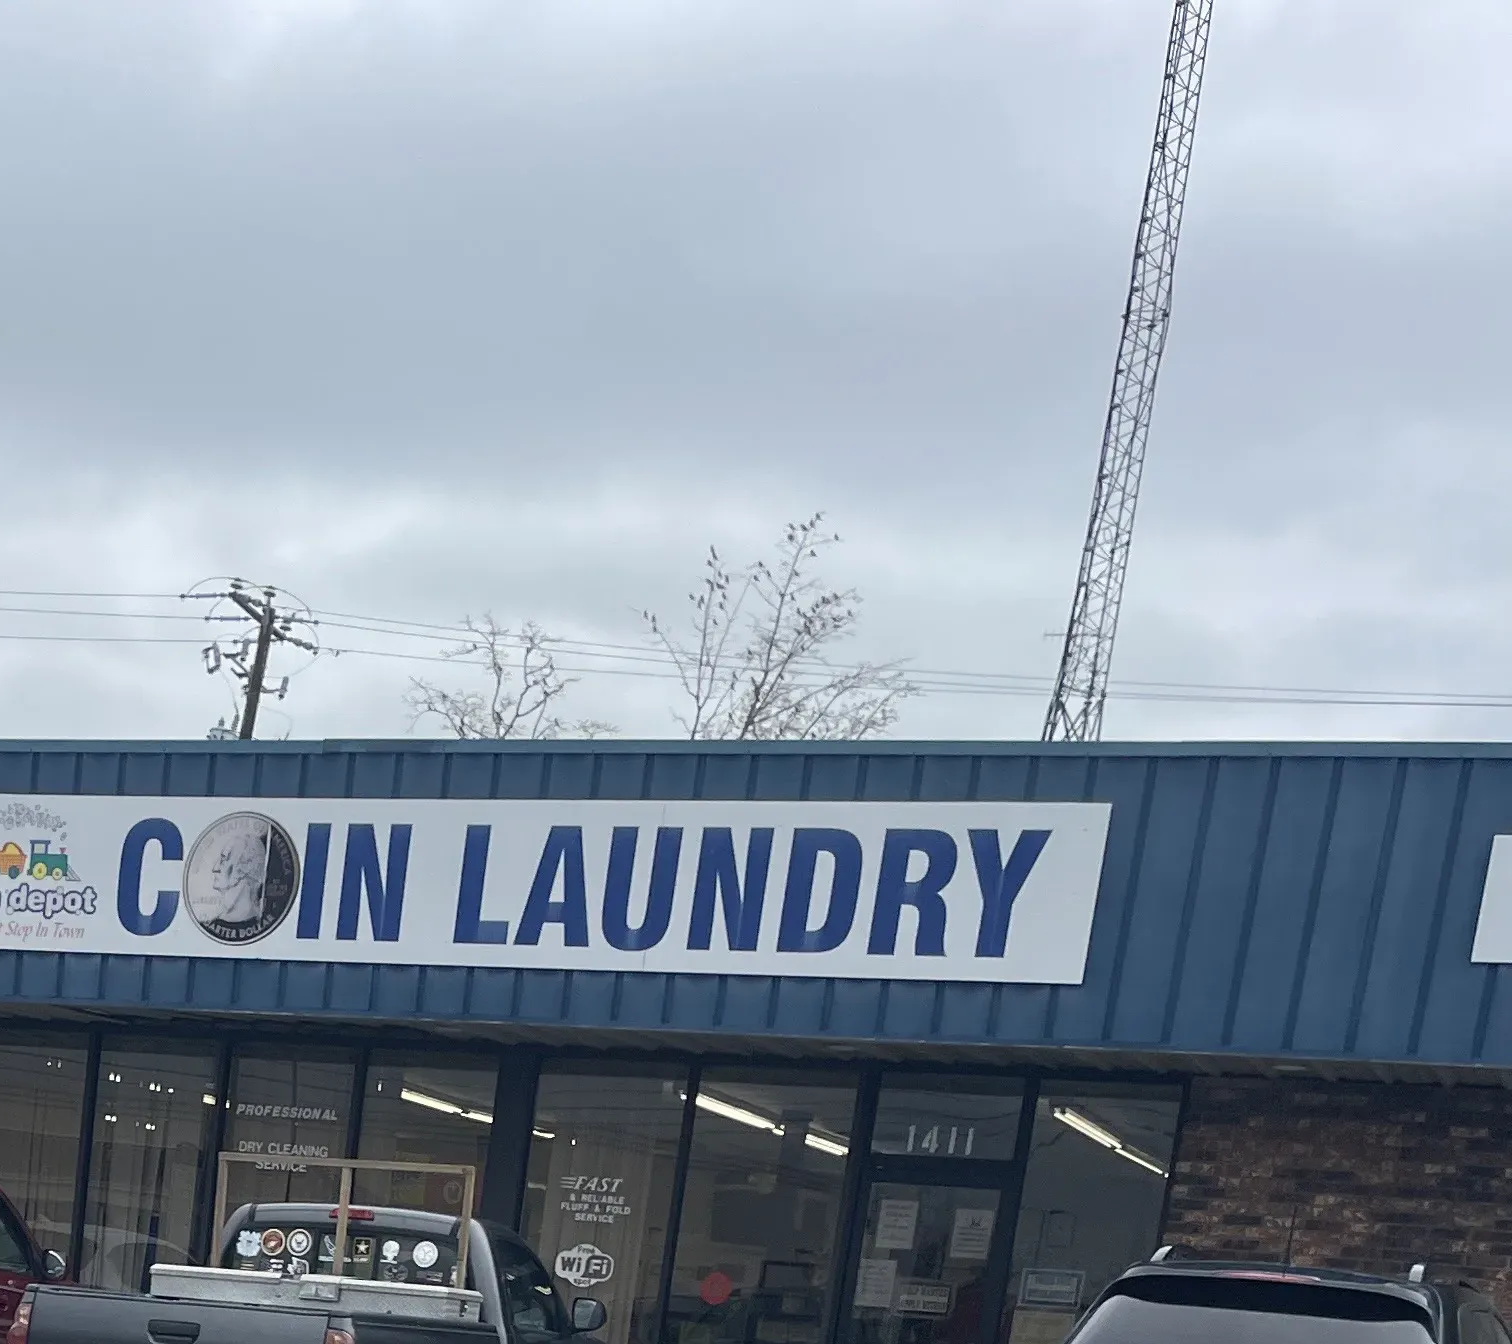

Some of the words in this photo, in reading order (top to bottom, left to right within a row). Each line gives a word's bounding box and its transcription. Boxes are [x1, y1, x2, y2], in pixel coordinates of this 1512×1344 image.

[453, 824, 1052, 958] LAUNDRY
[6, 883, 97, 919] depot
[5, 921, 33, 942] Stop
[36, 922, 48, 938] In
[51, 922, 85, 939] Town
[236, 1103, 338, 1120] PROFESSIONAL
[906, 1125, 975, 1156] 1411
[238, 1141, 263, 1153] DRY
[268, 1142, 329, 1158] CLEANING
[255, 1161, 308, 1173] SERVICE
[573, 1176, 624, 1193] FAST
[560, 1201, 590, 1211] FLUFF
[605, 1205, 632, 1215] FOLD
[574, 1212, 615, 1224] SERVICE
